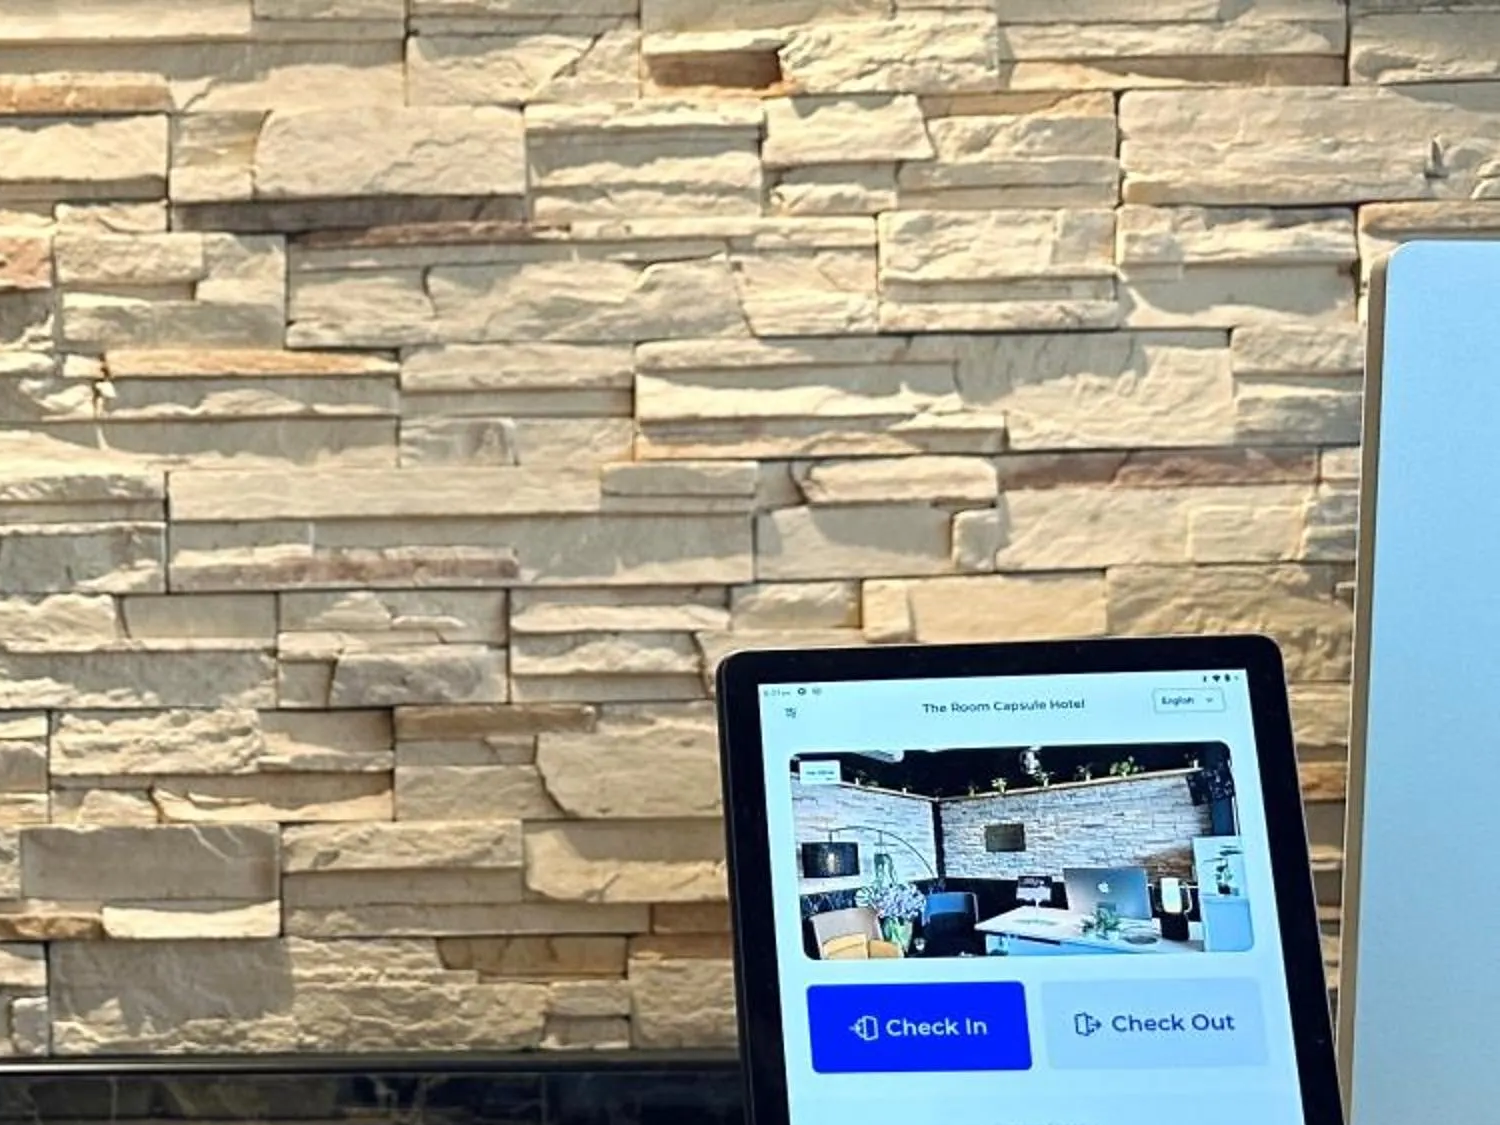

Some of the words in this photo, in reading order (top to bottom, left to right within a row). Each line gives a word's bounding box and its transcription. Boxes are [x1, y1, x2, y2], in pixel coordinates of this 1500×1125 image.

[922, 703, 947, 714] The
[950, 702, 990, 713] Room
[992, 700, 1047, 714] Capsule
[1049, 699, 1086, 711] Hotel
[1160, 695, 1195, 707] English
[885, 1018, 959, 1037] Check
[965, 1017, 988, 1036] In
[1111, 1013, 1184, 1034] Check
[1190, 1012, 1236, 1033] Out
